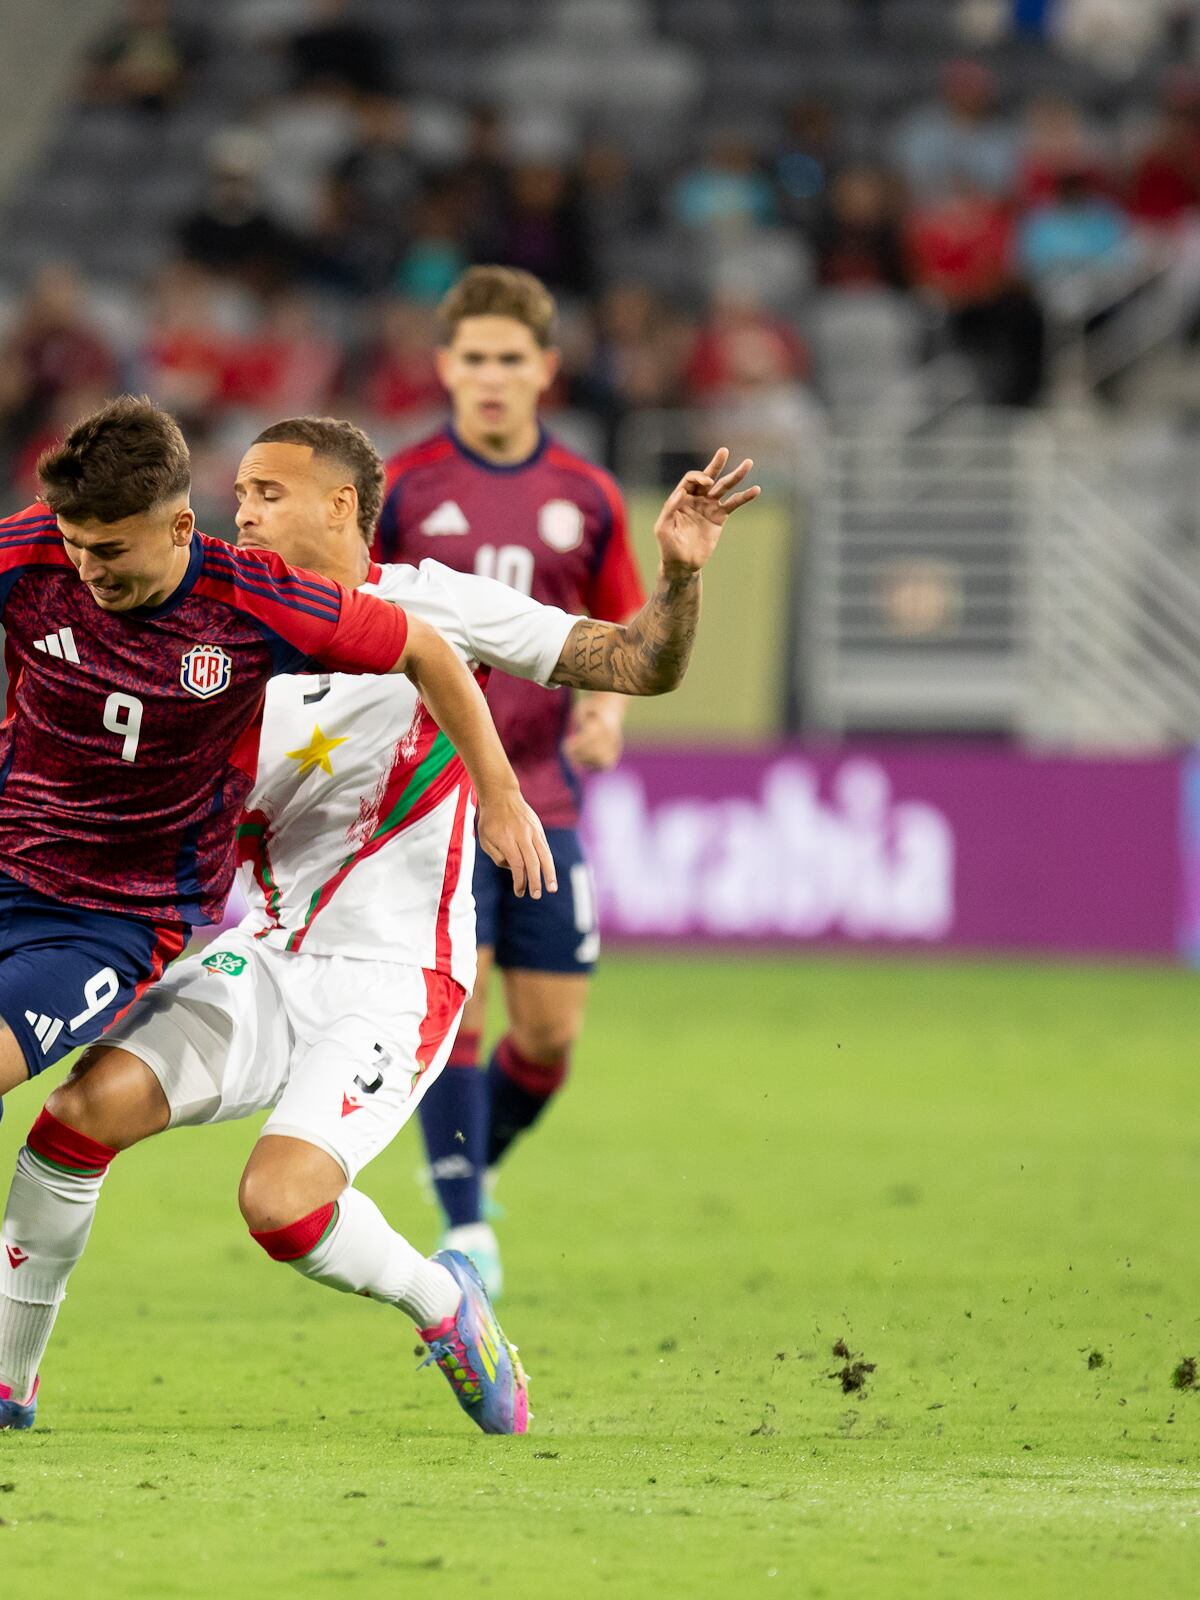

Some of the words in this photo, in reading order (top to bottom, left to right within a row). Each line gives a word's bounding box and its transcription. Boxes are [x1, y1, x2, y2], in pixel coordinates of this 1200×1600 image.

[192, 655, 220, 688] CR
[102, 691, 144, 763] 9
[69, 965, 120, 1032] 9
[352, 1042, 393, 1094] 3
